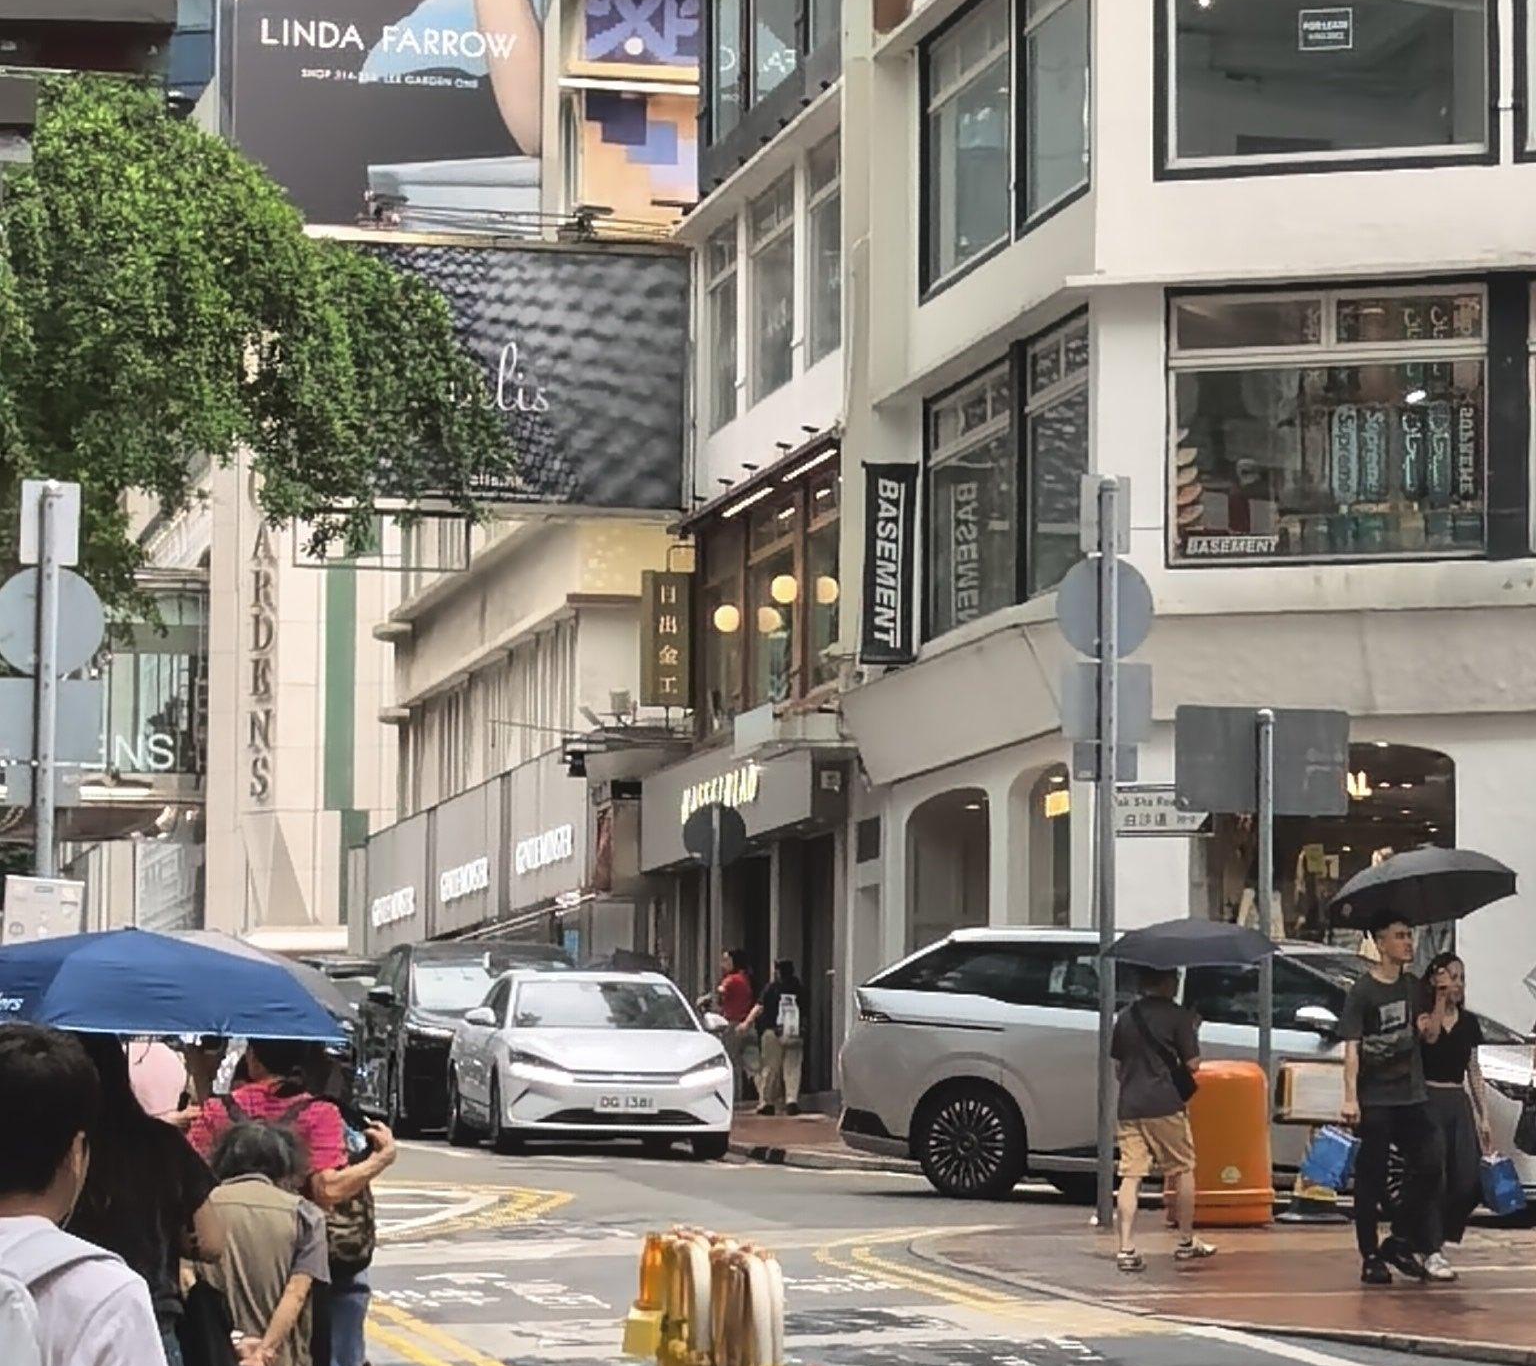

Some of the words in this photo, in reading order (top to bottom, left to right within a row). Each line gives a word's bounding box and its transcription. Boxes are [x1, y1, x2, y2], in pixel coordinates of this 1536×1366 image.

[260, 18, 364, 50] LINDA
[382, 25, 518, 59] FARROW
[873, 477, 900, 649] BASEMENT
[1186, 538, 1278, 556] BASEMENT
[658, 584, 679, 695] 日出金工
